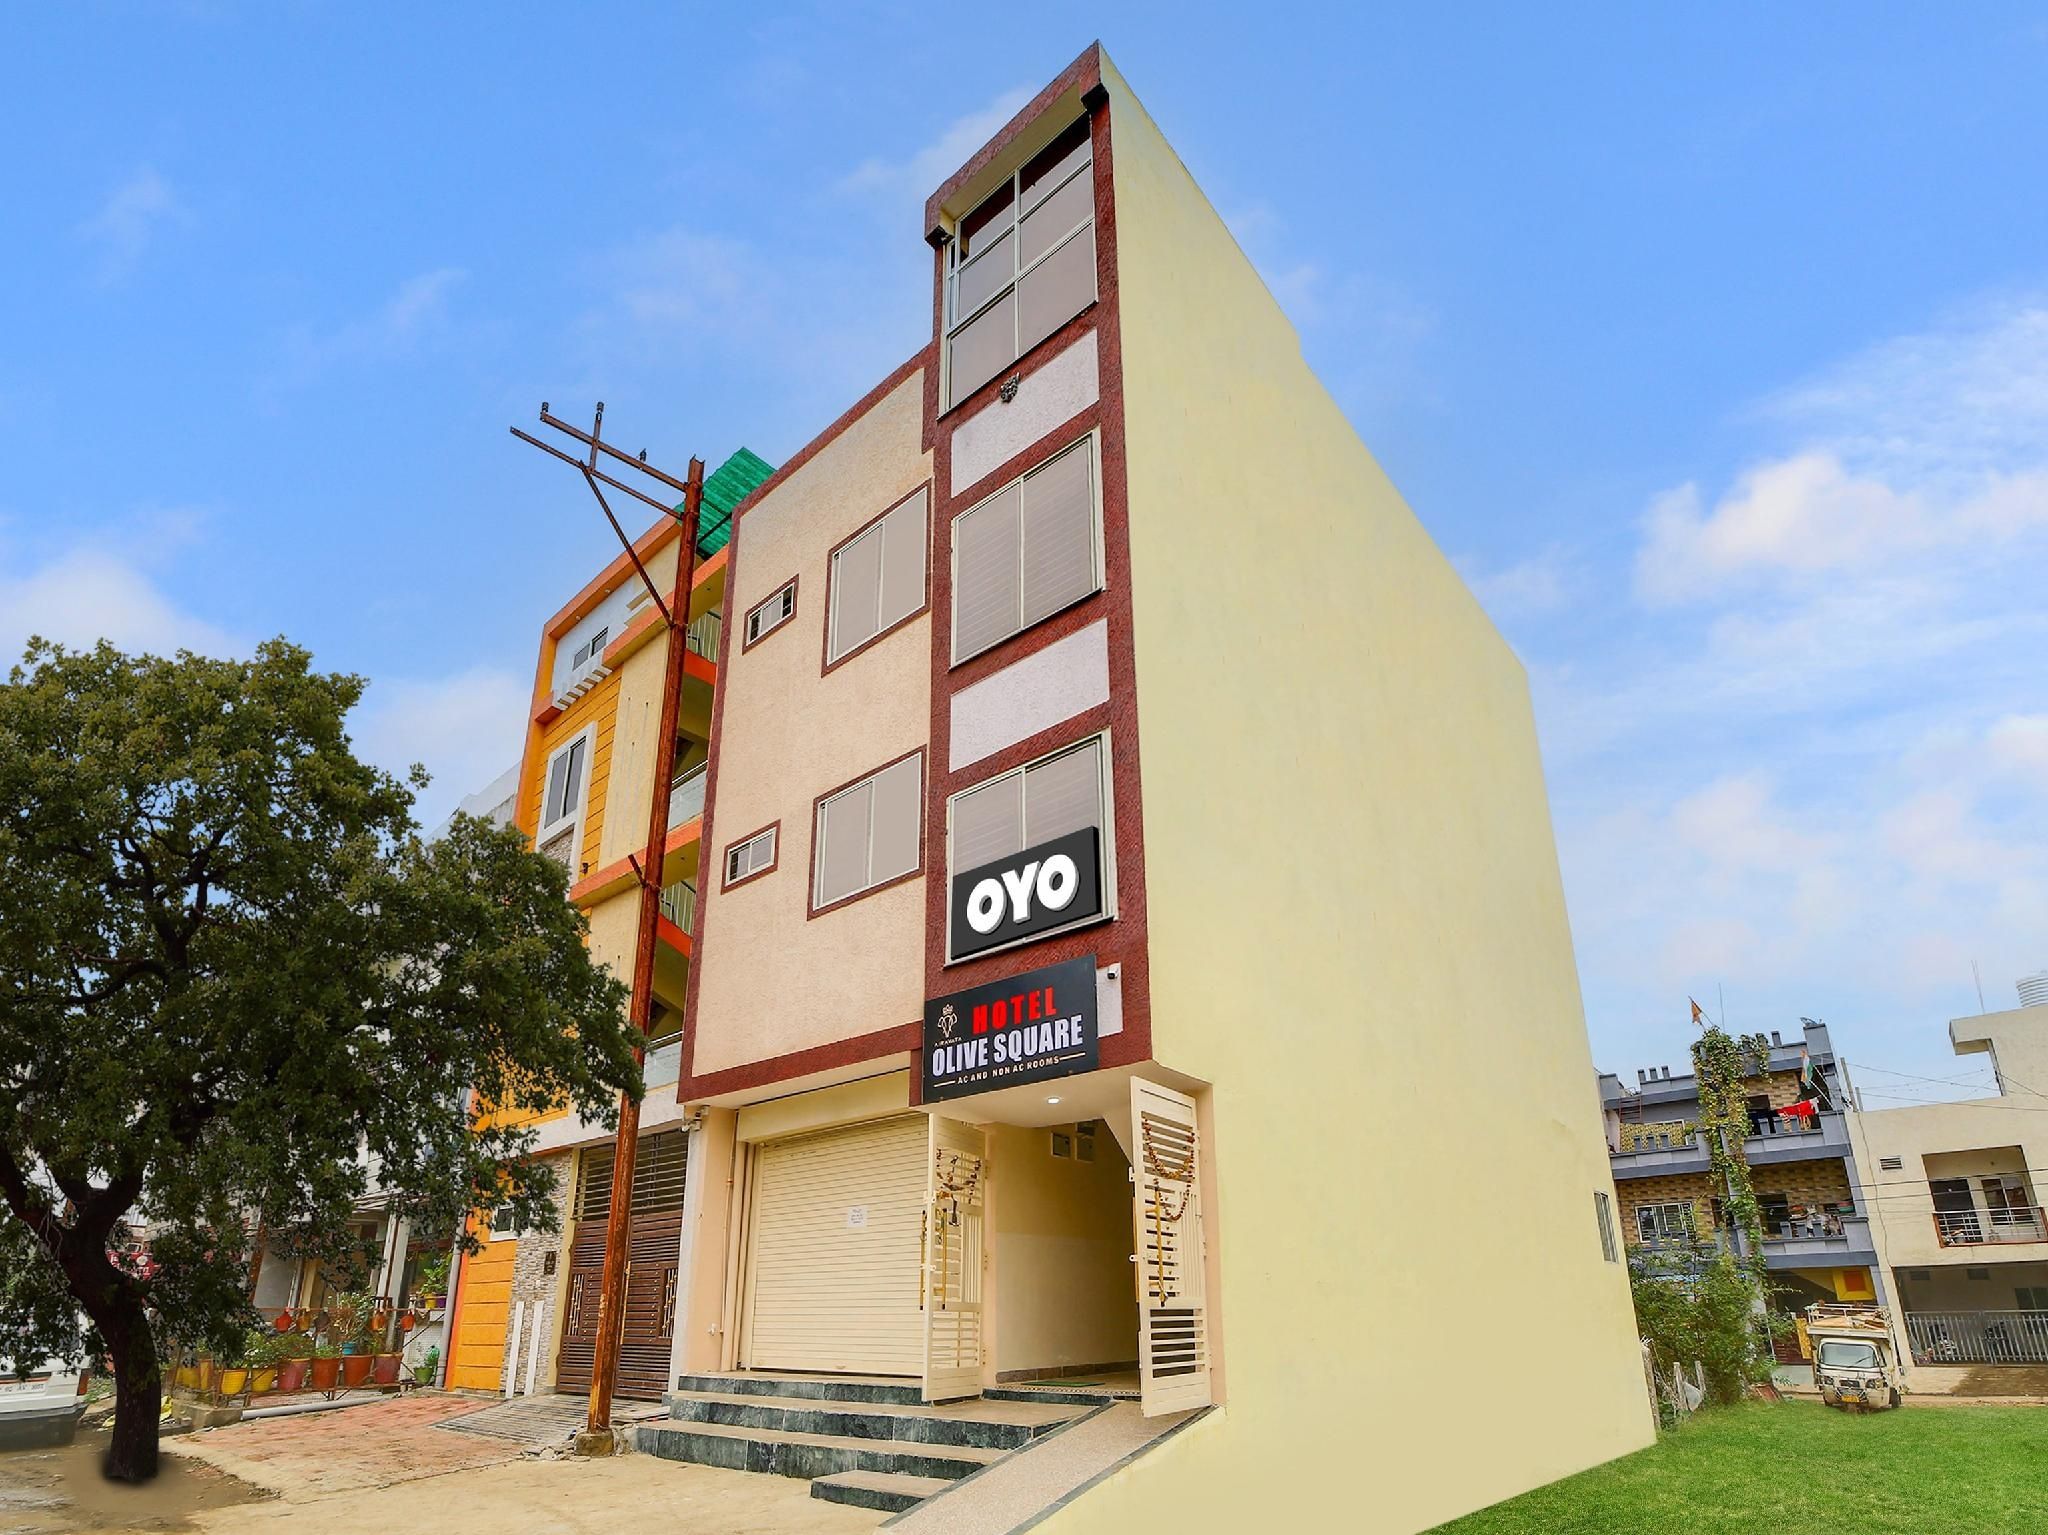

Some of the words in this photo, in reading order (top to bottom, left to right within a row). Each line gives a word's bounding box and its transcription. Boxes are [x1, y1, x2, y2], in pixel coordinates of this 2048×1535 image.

[967, 854, 1080, 934] OYO
[972, 986, 1057, 1035] HOTEL
[932, 1037, 989, 1077] OLIVE
[993, 1014, 1083, 1063] SQUARE
[957, 1075, 969, 1084] AC
[970, 1071, 988, 1081] AND
[992, 1067, 1011, 1077] NON
[1012, 1063, 1024, 1073] AC
[1027, 1056, 1060, 1070] ROOMS
